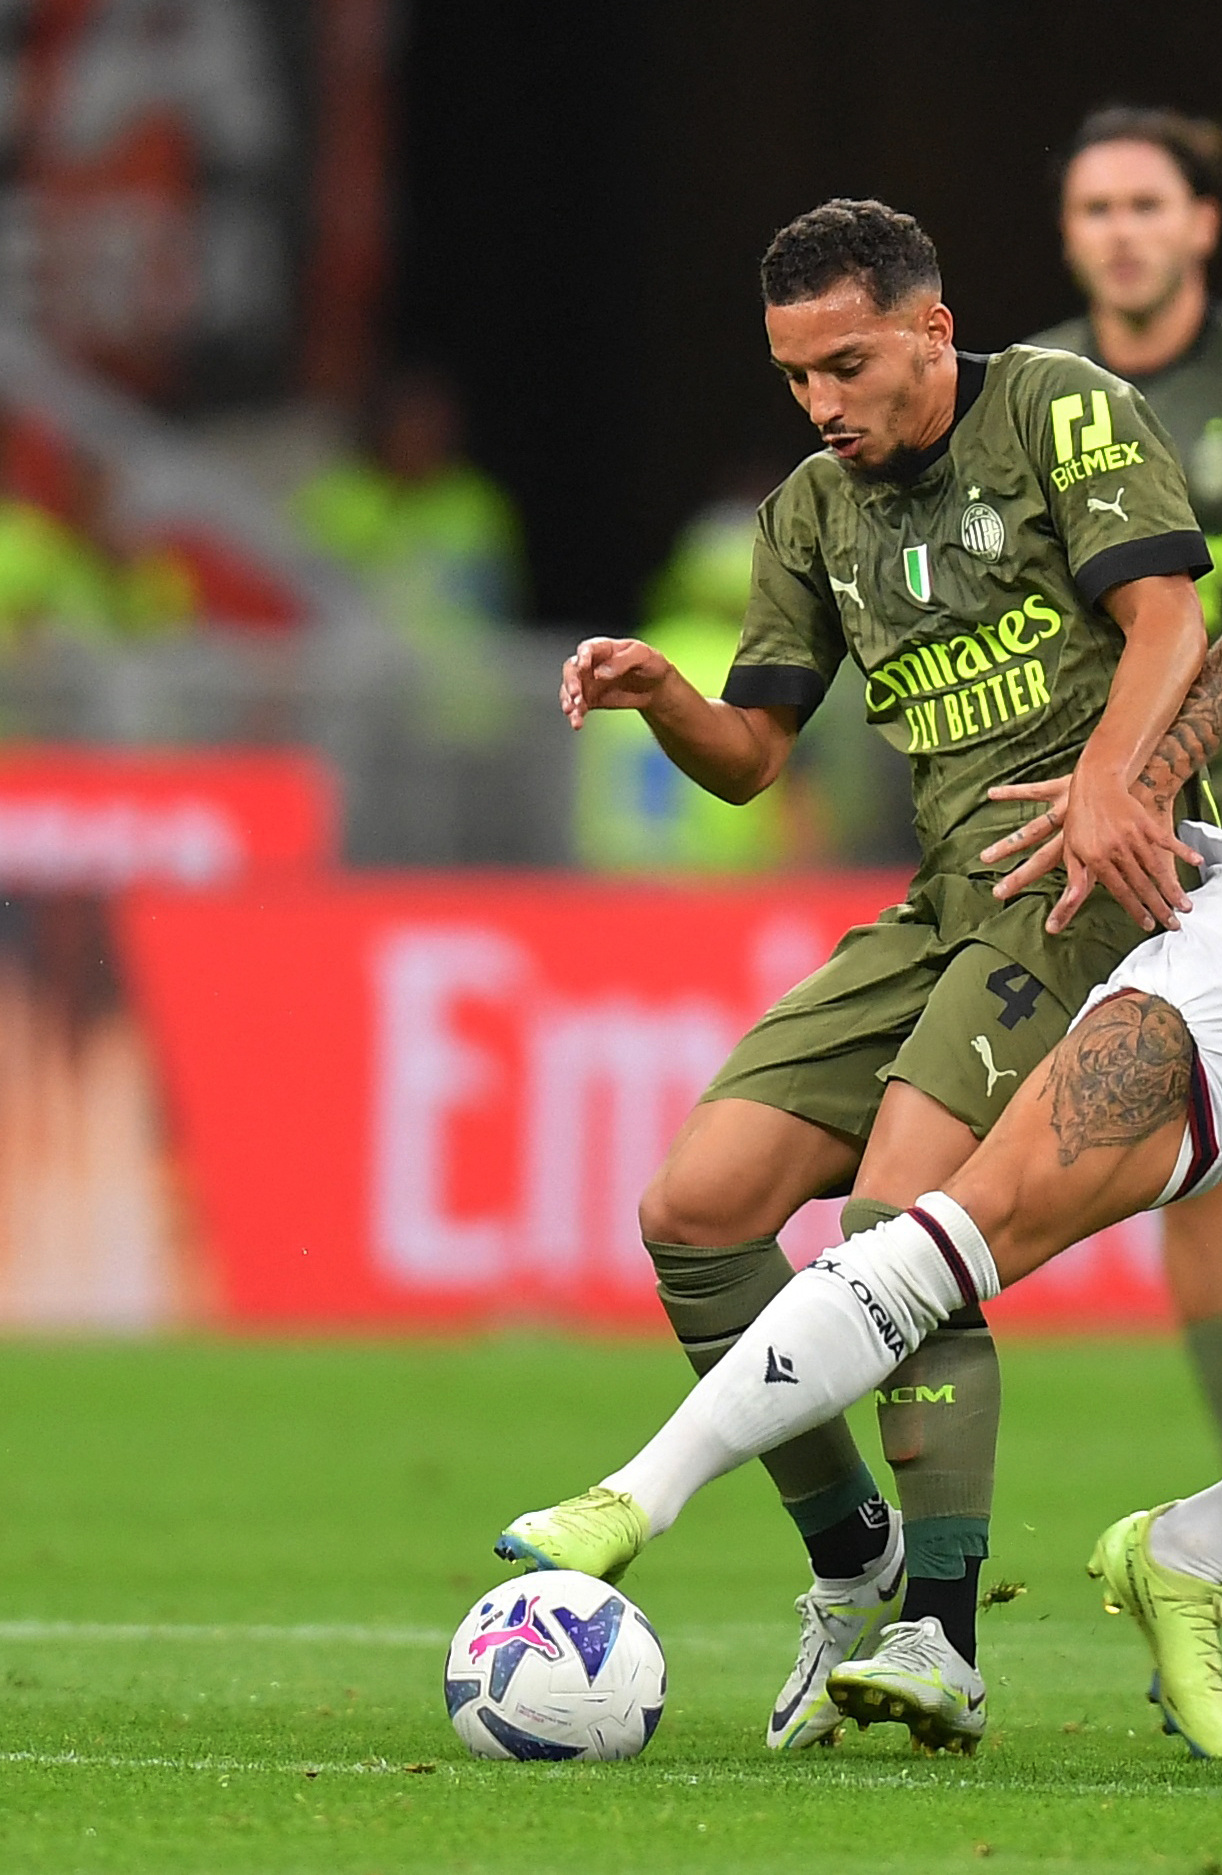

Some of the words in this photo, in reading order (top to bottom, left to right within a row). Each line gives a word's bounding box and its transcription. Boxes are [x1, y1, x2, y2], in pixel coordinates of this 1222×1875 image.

[1051, 441, 1144, 492] BitMEX
[905, 699, 940, 751] FLY
[943, 659, 1051, 742] BETTER
[985, 962, 1045, 1031] 4
